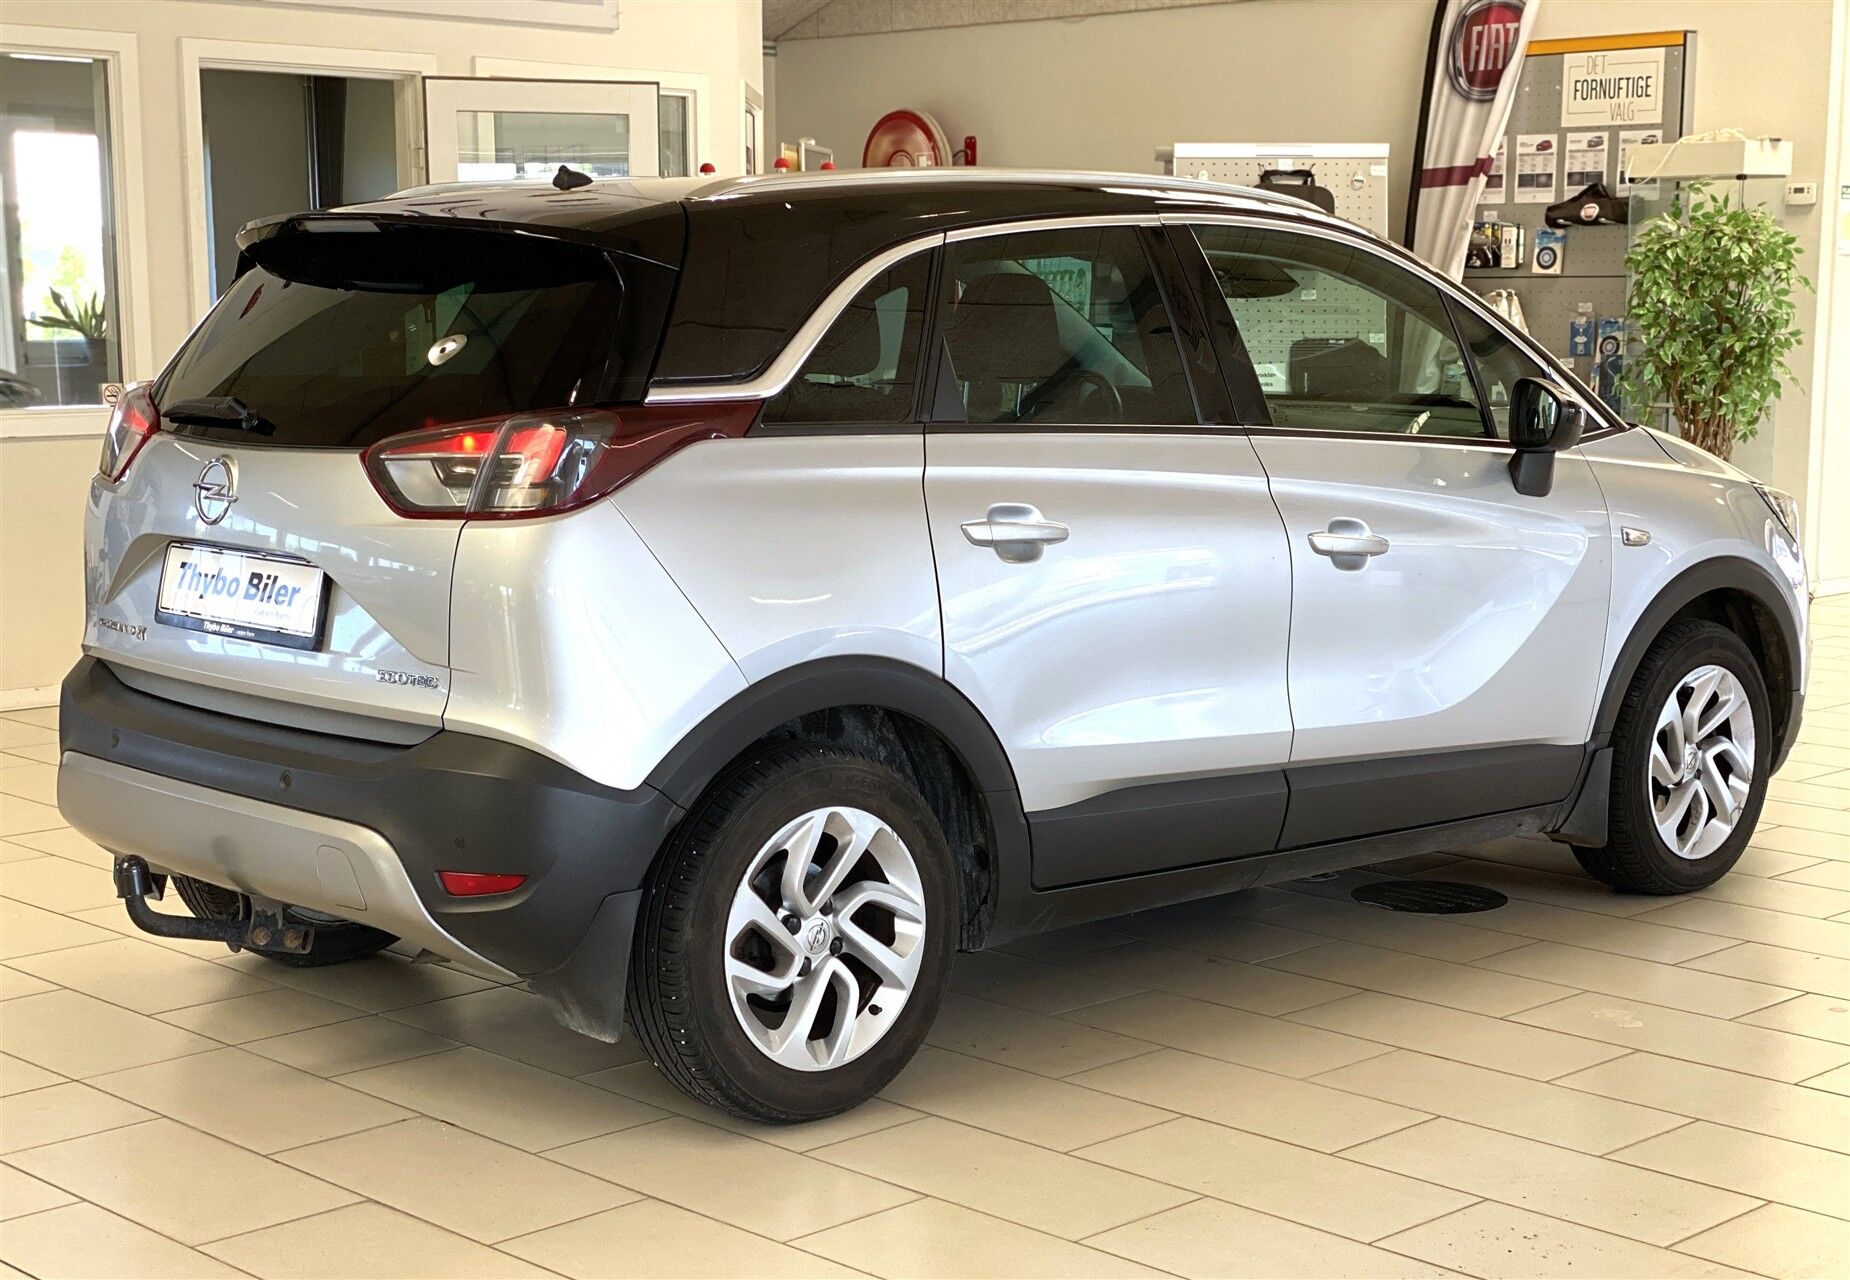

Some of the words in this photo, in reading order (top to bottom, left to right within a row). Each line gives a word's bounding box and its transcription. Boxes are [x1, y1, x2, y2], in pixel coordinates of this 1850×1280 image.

[1468, 22, 1518, 72] FIAT
[1586, 54, 1608, 75] DET
[1573, 75, 1652, 101] FORNUFTIGE
[1609, 101, 1635, 121] VALG
[177, 561, 240, 599] Thybo
[243, 571, 301, 607] Biler
[203, 621, 219, 632] Thybo
[220, 624, 235, 634] Biler
